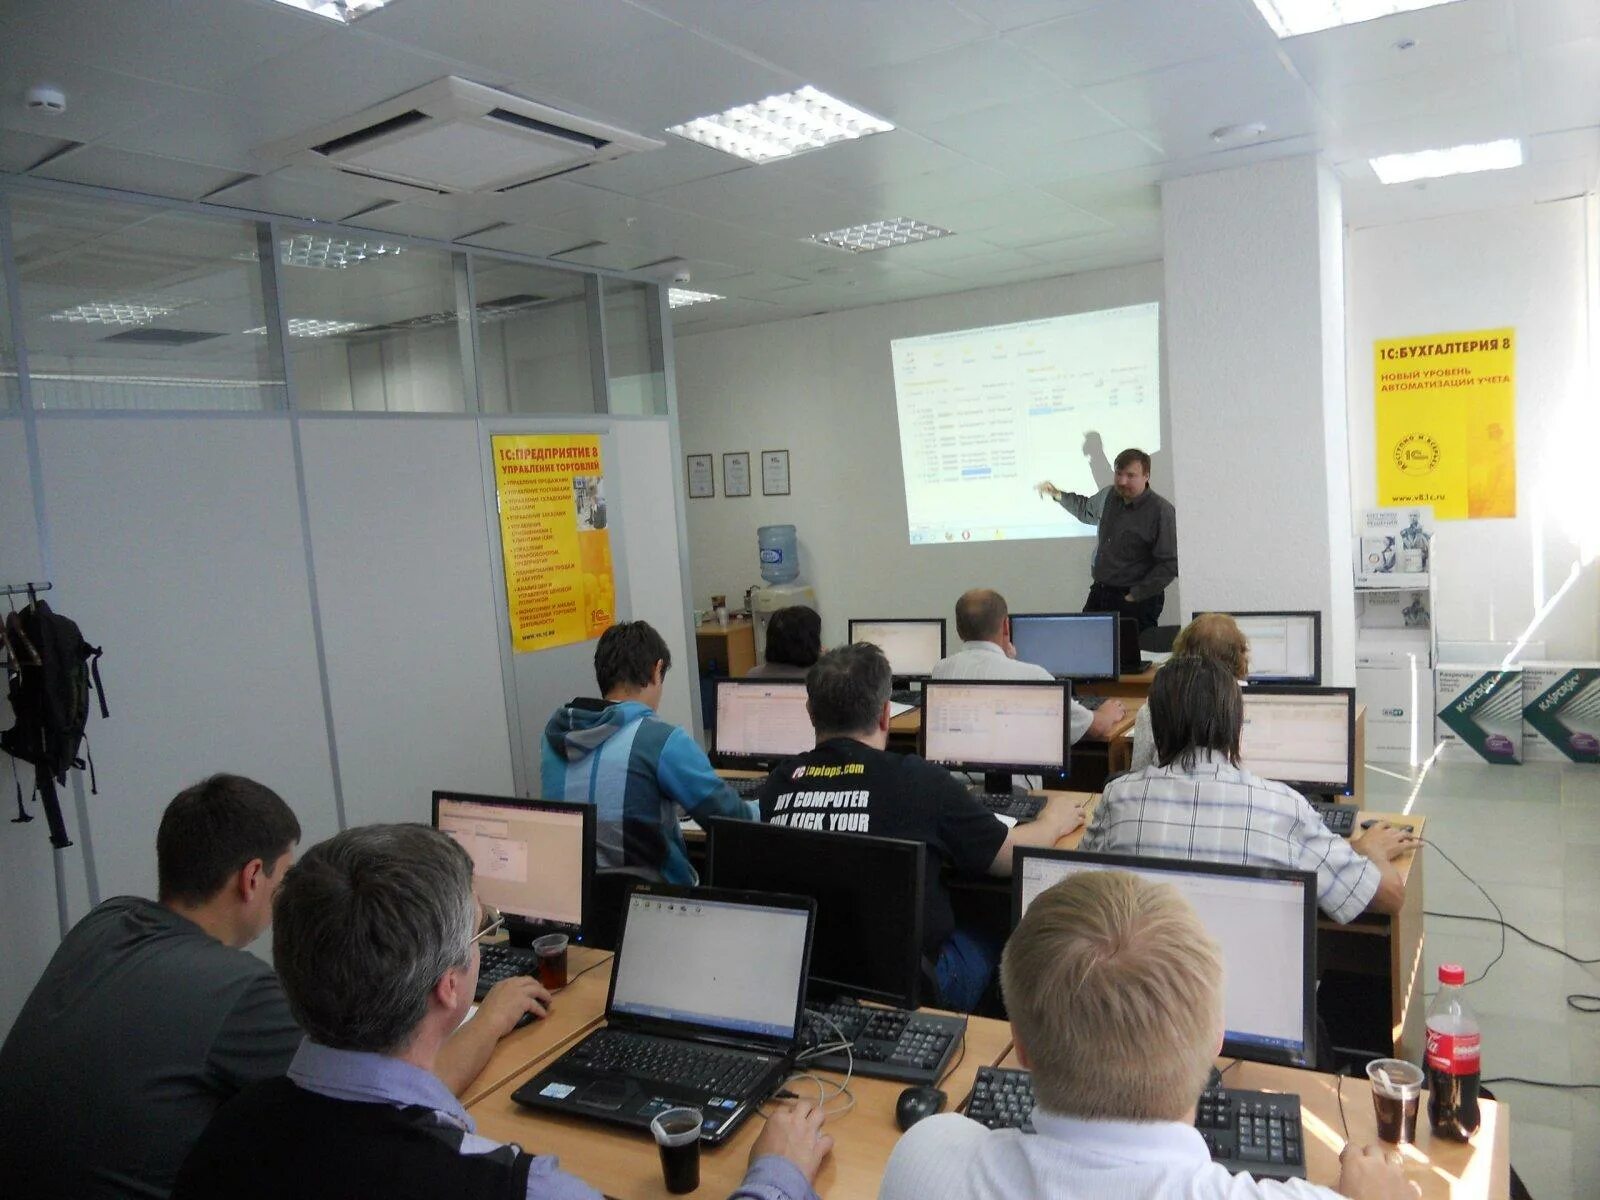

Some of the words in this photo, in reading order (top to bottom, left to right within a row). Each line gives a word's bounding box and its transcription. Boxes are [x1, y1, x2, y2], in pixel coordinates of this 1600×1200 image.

[1380, 338, 1499, 361] 1С:БУХГАЛТЕРИЯ
[1502, 338, 1511, 350] 8
[1381, 369, 1421, 382] НОВЫЙ
[1423, 367, 1472, 378] УРОВЕНЬ
[1381, 378, 1475, 393] АВТОМАТИЗАЦИИ
[1478, 375, 1511, 386] УЧЕТА
[500, 447, 590, 461] 1С:ПРЕДПРИЯТИЕ
[592, 446, 599, 458] 8
[502, 464, 555, 475] УПРАВЛЕНИЕ
[556, 460, 600, 472] ТОРГОВЛЕЙ
[774, 792, 794, 811] MY
[793, 790, 870, 808] COMPUTER
[790, 812, 825, 831] KICK
[829, 813, 870, 833] YOUR
